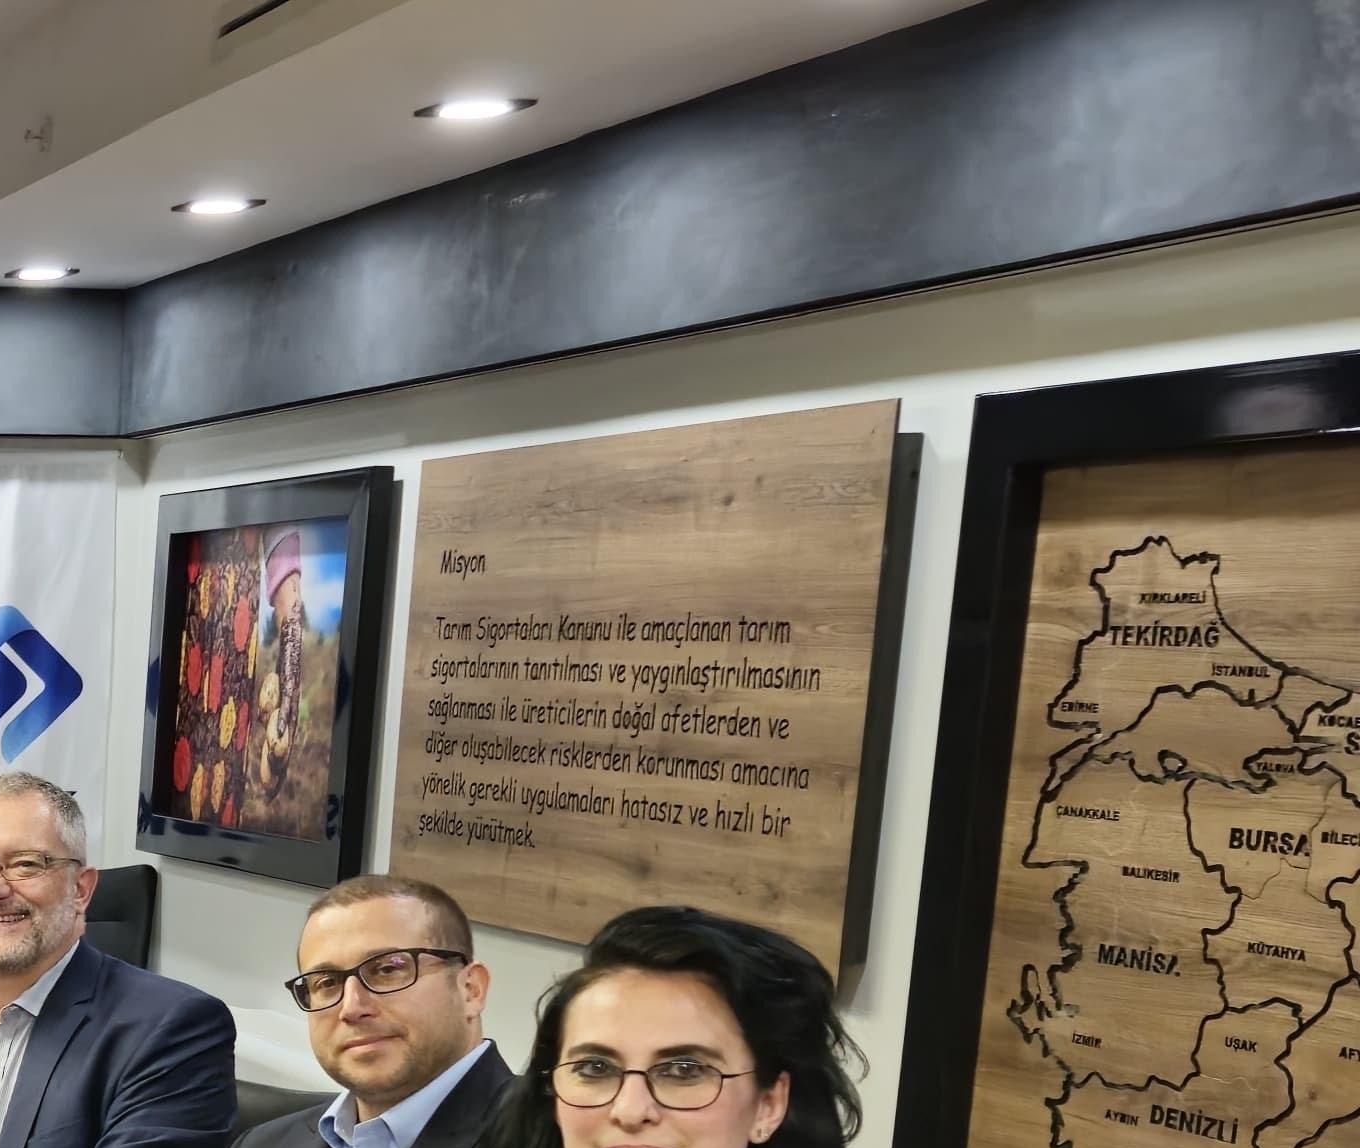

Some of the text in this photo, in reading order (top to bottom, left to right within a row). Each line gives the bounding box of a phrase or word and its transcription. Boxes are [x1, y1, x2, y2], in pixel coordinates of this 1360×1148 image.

[440, 550, 486, 580] Misyon
[436, 612, 791, 648] Tarım Sigortaları Kanunu ile amaçlanan tarım
[1110, 619, 1221, 648] TEKİRDAĞ
[431, 655, 821, 694] sigortalarının tanıtılması ve yaygınlaştırılmasının
[428, 693, 790, 740] sağlanması ile üreticilerin doğal afetlerden ve
[1317, 714, 1360, 729] KOCAE
[425, 734, 809, 790] diğer oluşabilecek risklerden korunması amacına
[422, 773, 791, 839] yönelik gerekli uygulamaları hatasız ve hızlı bir
[418, 813, 536, 849] şekilde yürütmek.
[1229, 827, 1311, 858] BURSA
[1098, 943, 1180, 977] MANİSA
[1247, 940, 1306, 963] KÜTAHYA
[1225, 1036, 1257, 1054] UŞAK
[1149, 1103, 1240, 1144] DENİZLİ
